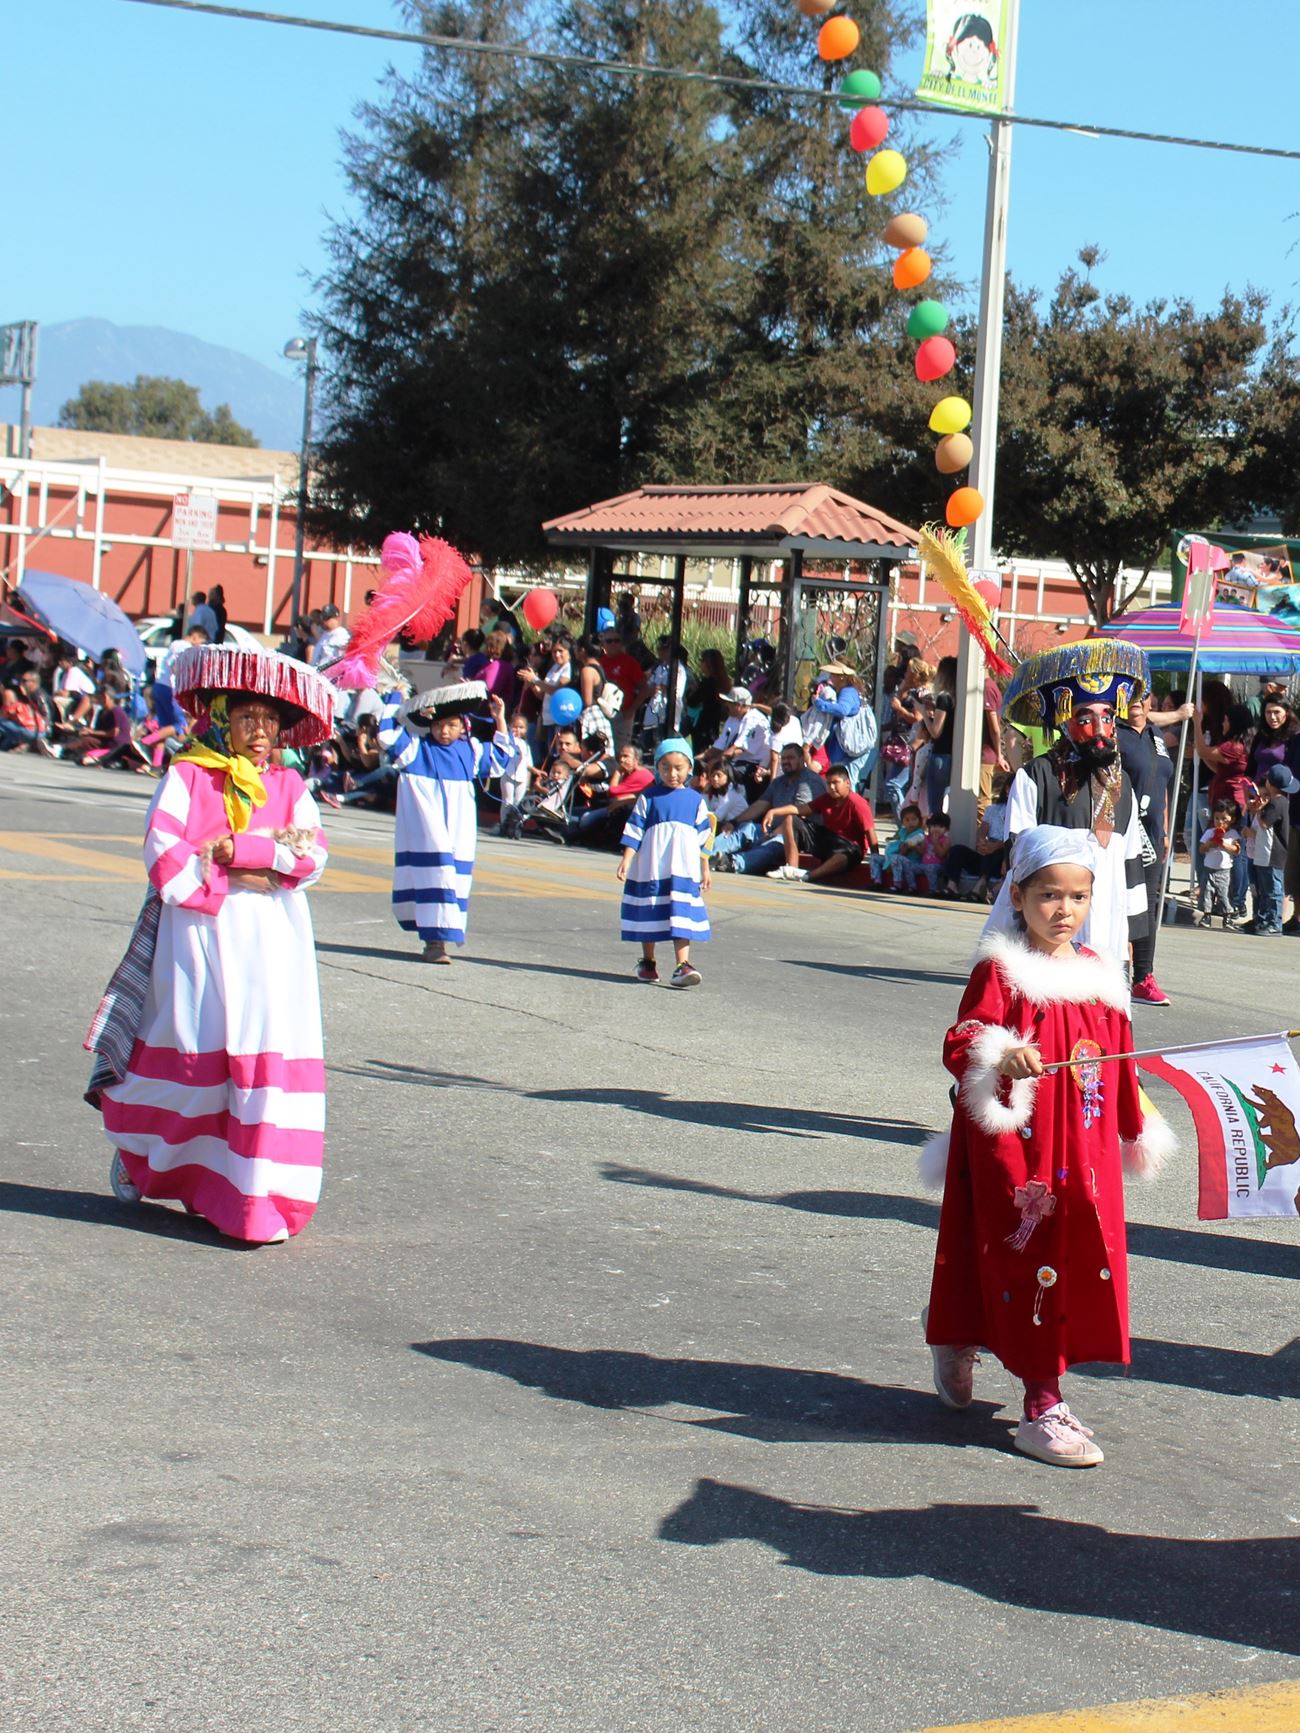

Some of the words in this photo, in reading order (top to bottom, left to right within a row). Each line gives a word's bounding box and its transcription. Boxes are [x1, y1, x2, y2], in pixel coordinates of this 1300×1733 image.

[175, 495, 188, 506] NO
[176, 508, 212, 519] PARKING
[1196, 1071, 1240, 1124] CALIFORNIA
[1231, 1129, 1250, 1198] REPUBLIC
